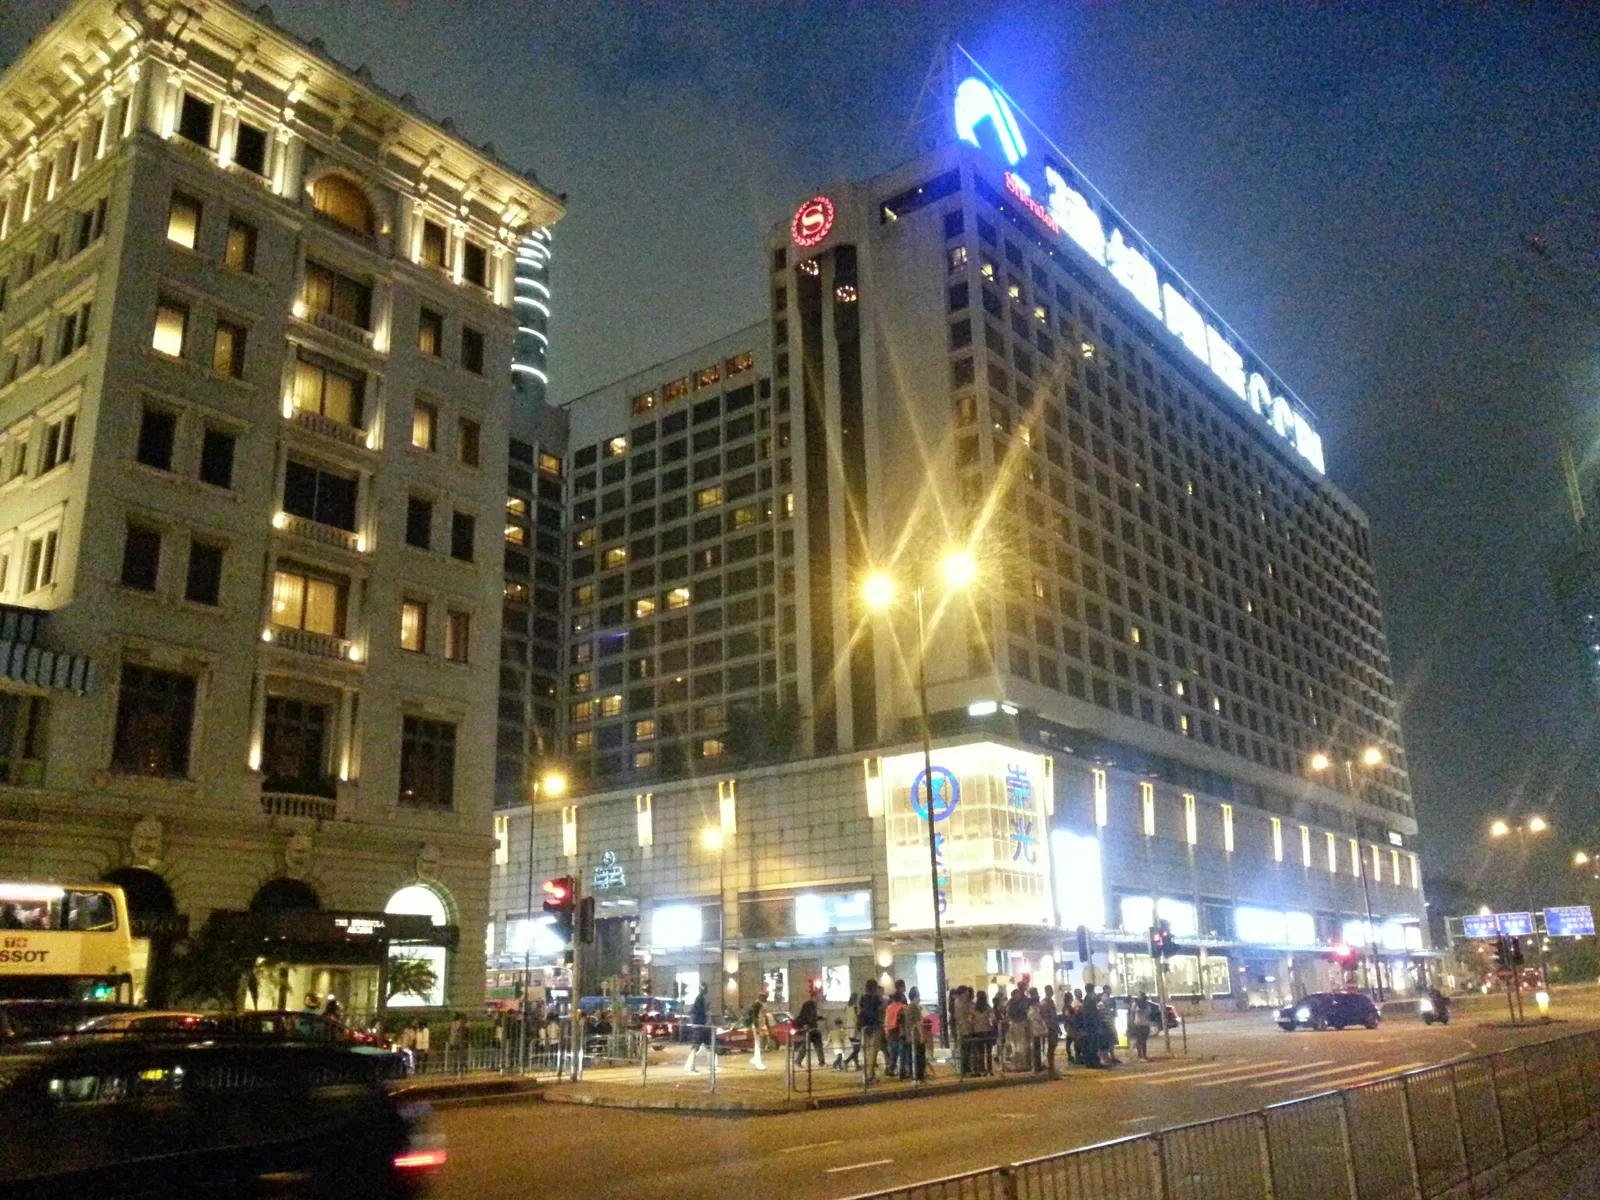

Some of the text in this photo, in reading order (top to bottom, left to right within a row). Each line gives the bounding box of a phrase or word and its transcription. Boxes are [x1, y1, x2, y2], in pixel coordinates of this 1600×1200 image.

[802, 203, 824, 237] S
[1004, 171, 1059, 234] Sheraton
[1006, 763, 1039, 864] 崇光
[0, 950, 50, 963] SSOT
